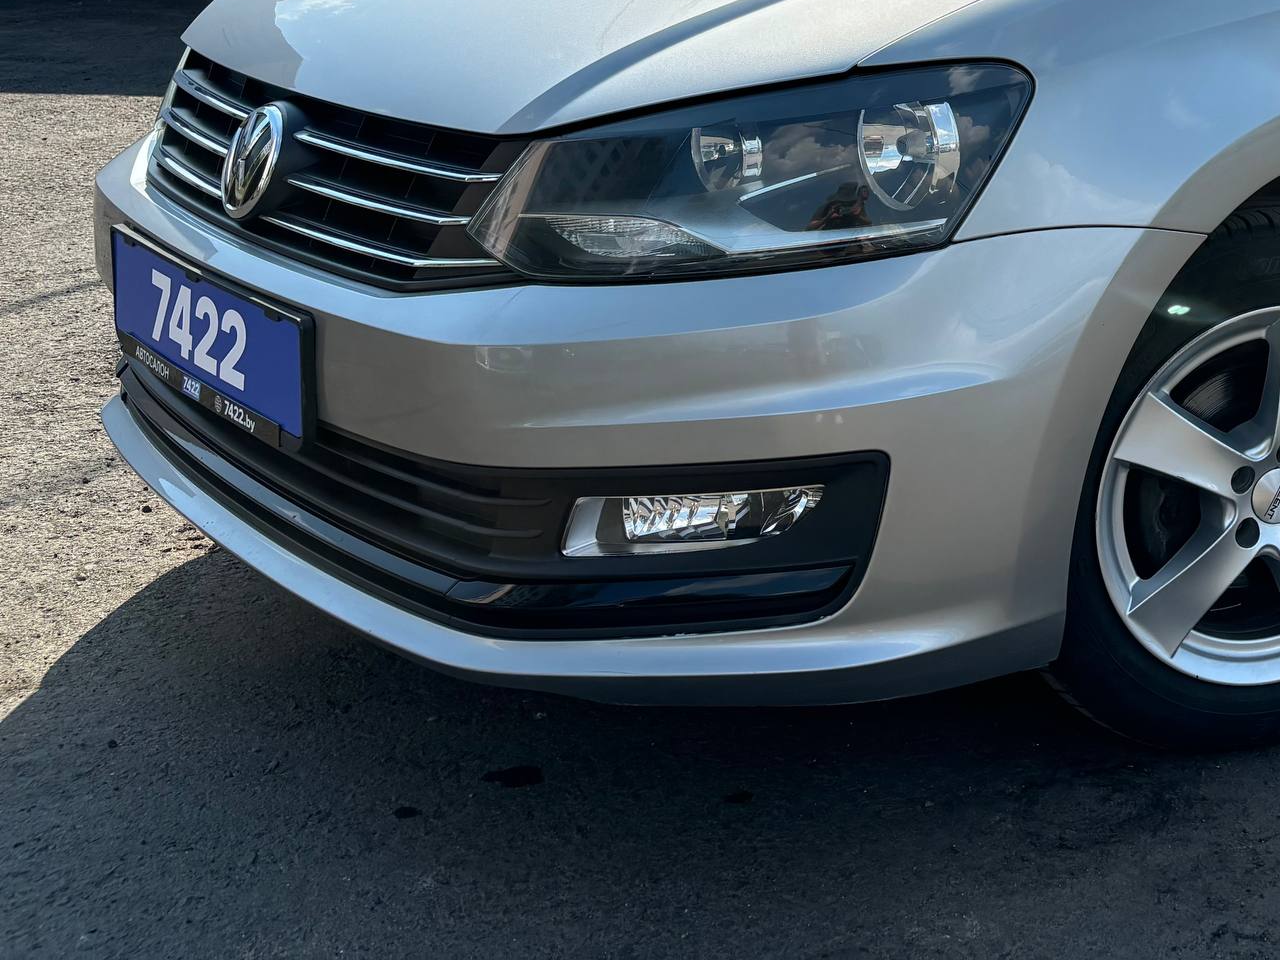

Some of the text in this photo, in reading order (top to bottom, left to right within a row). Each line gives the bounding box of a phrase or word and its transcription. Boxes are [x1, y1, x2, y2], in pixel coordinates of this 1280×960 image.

[151, 268, 247, 392] 7422
[135, 345, 256, 433] АВТОСАЛОН 7422 7422.by
